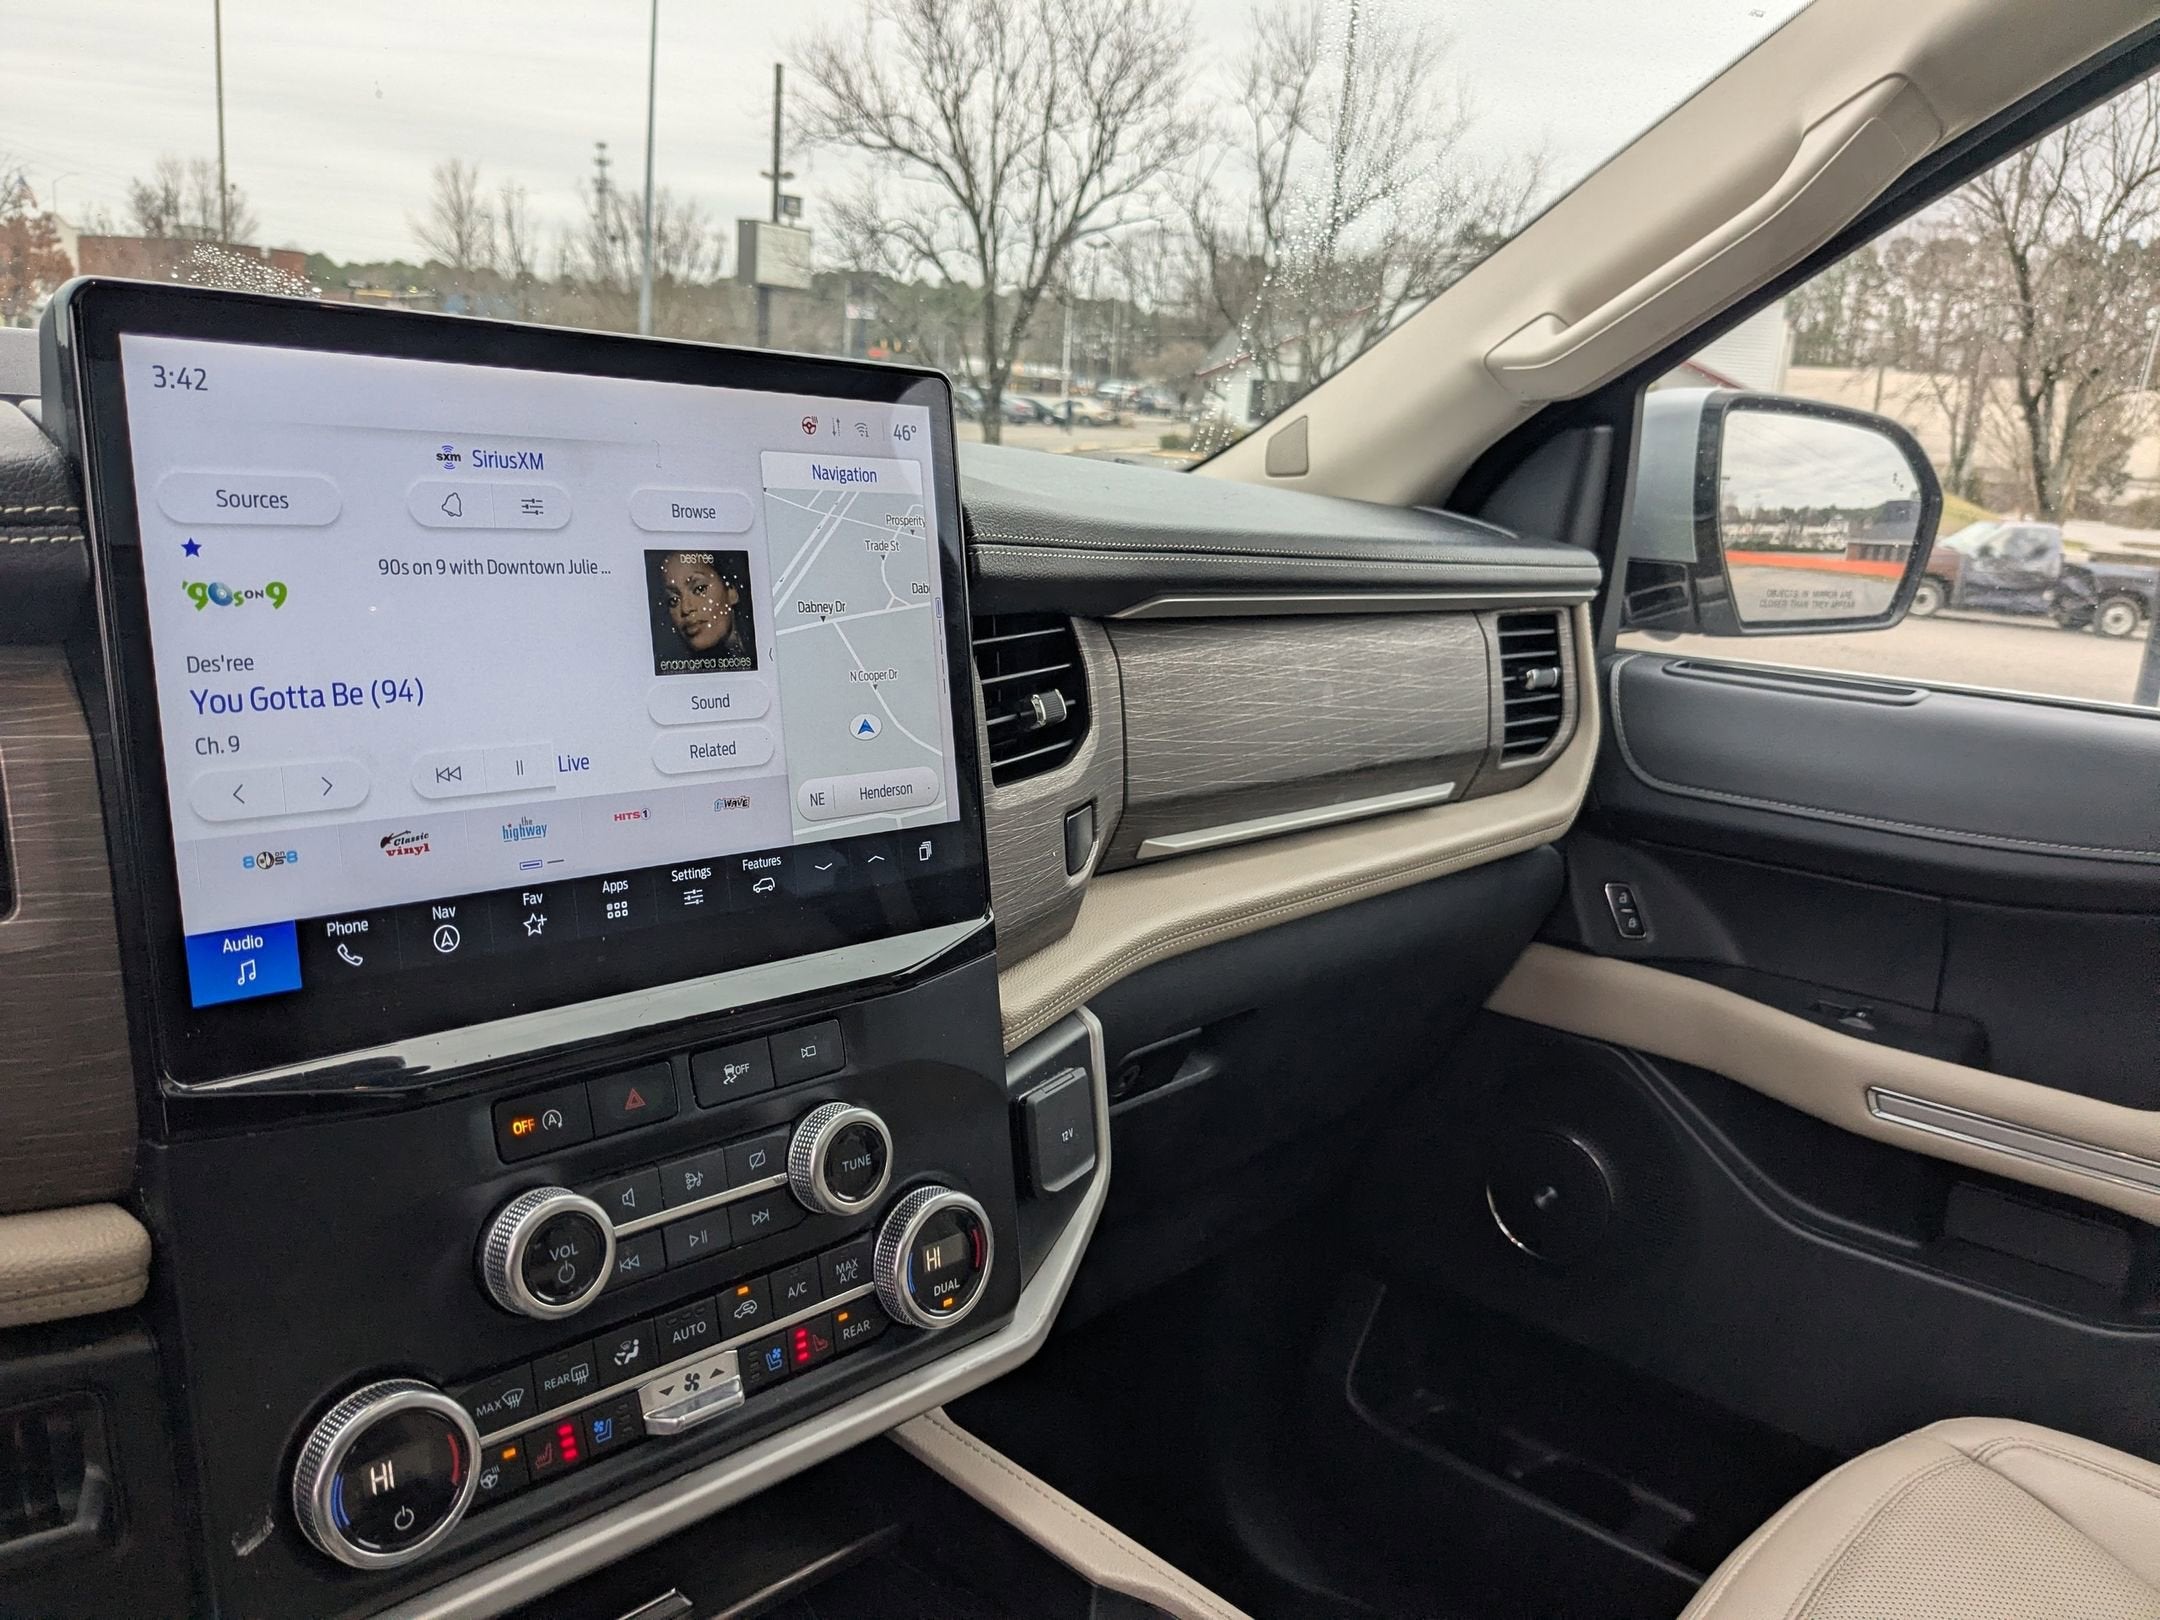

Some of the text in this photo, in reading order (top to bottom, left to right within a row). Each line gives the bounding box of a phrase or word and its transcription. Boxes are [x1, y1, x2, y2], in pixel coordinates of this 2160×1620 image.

[152, 365, 209, 392] 3:42
[472, 449, 544, 471] SiriusXM
[812, 464, 877, 484] Navigation
[216, 489, 289, 511] Sources
[671, 503, 716, 520] Browse
[886, 514, 926, 528] Prosperity
[865, 540, 900, 551] Trade St
[378, 559, 410, 576] 90s
[412, 563, 433, 576] on
[436, 559, 447, 576] 9
[449, 559, 484, 576] with
[487, 559, 565, 576] Downtown
[568, 559, 598, 576] Julie
[912, 582, 930, 594] Dab
[798, 601, 846, 615] Dabney Dr
[187, 655, 254, 674] Des'ree
[661, 656, 752, 671] endangered species
[850, 669, 898, 684] N Cooper Dr
[190, 677, 425, 716] You Gotta Be (94)
[691, 694, 730, 711] Sound
[195, 735, 240, 757] Ch. 9
[689, 741, 737, 760] Related
[558, 754, 590, 774] Live
[809, 782, 913, 807] NE Henderson
[393, 832, 429, 847] Classic
[502, 823, 547, 842] highway
[386, 843, 430, 857] vinyl
[742, 855, 782, 872] Features
[671, 866, 712, 883] Settings
[602, 880, 628, 895] Apps
[522, 892, 543, 907] Fav
[432, 906, 456, 921] Nav
[326, 919, 369, 937] Phone
[222, 934, 264, 954] Audio
[735, 1062, 750, 1076] OFF
[512, 1117, 536, 1137] OFF
[842, 1153, 872, 1173] TUNE
[549, 1243, 579, 1261] VOL
[925, 1246, 942, 1272] HI
[835, 1256, 859, 1276] MAX
[838, 1267, 858, 1285] A/C
[787, 1281, 807, 1300] A/C
[933, 1278, 960, 1298] DUAL
[672, 1321, 706, 1344] AUTO
[843, 1320, 871, 1341] REAR
[544, 1372, 571, 1391] REAR
[475, 1399, 502, 1418] MAX
[370, 1460, 395, 1497] HI
